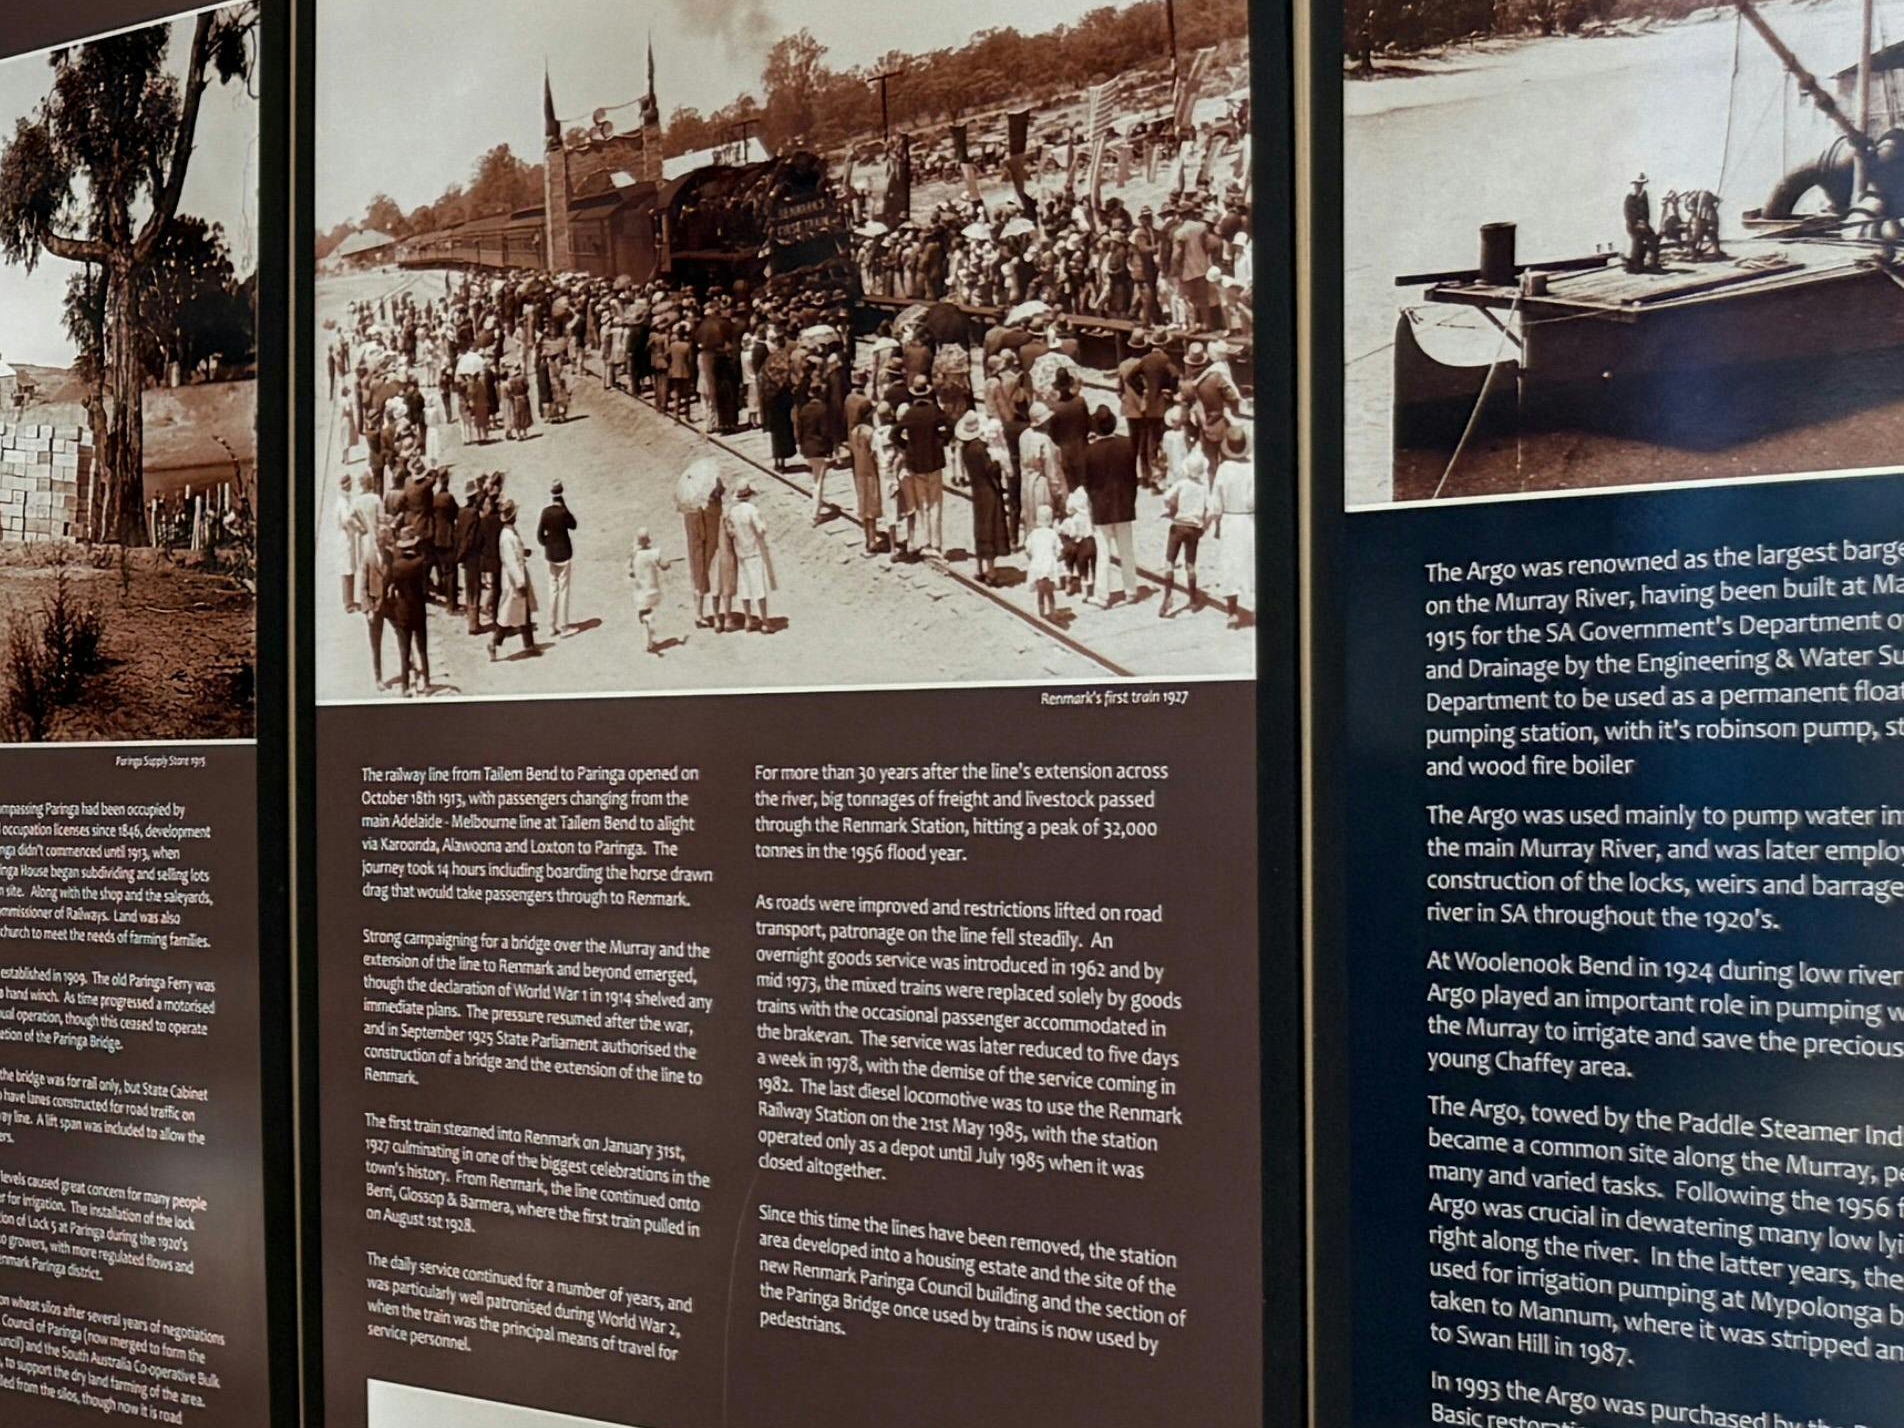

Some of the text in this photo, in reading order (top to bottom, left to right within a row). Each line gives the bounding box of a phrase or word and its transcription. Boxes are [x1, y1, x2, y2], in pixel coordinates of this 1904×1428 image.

[1040, 689, 1189, 708] Renmark's first train 1927
[1426, 753, 1635, 777] and wood fire boiler
[755, 842, 968, 865] tonnes in the 1956 flood year.
[1427, 901, 1780, 933] river in SA throughout the 1920's.
[758, 1151, 887, 1182] closed altogether.
[759, 1310, 847, 1336] pedestrians.
[1430, 1322, 1635, 1367] to Swan Hill in 1987.
